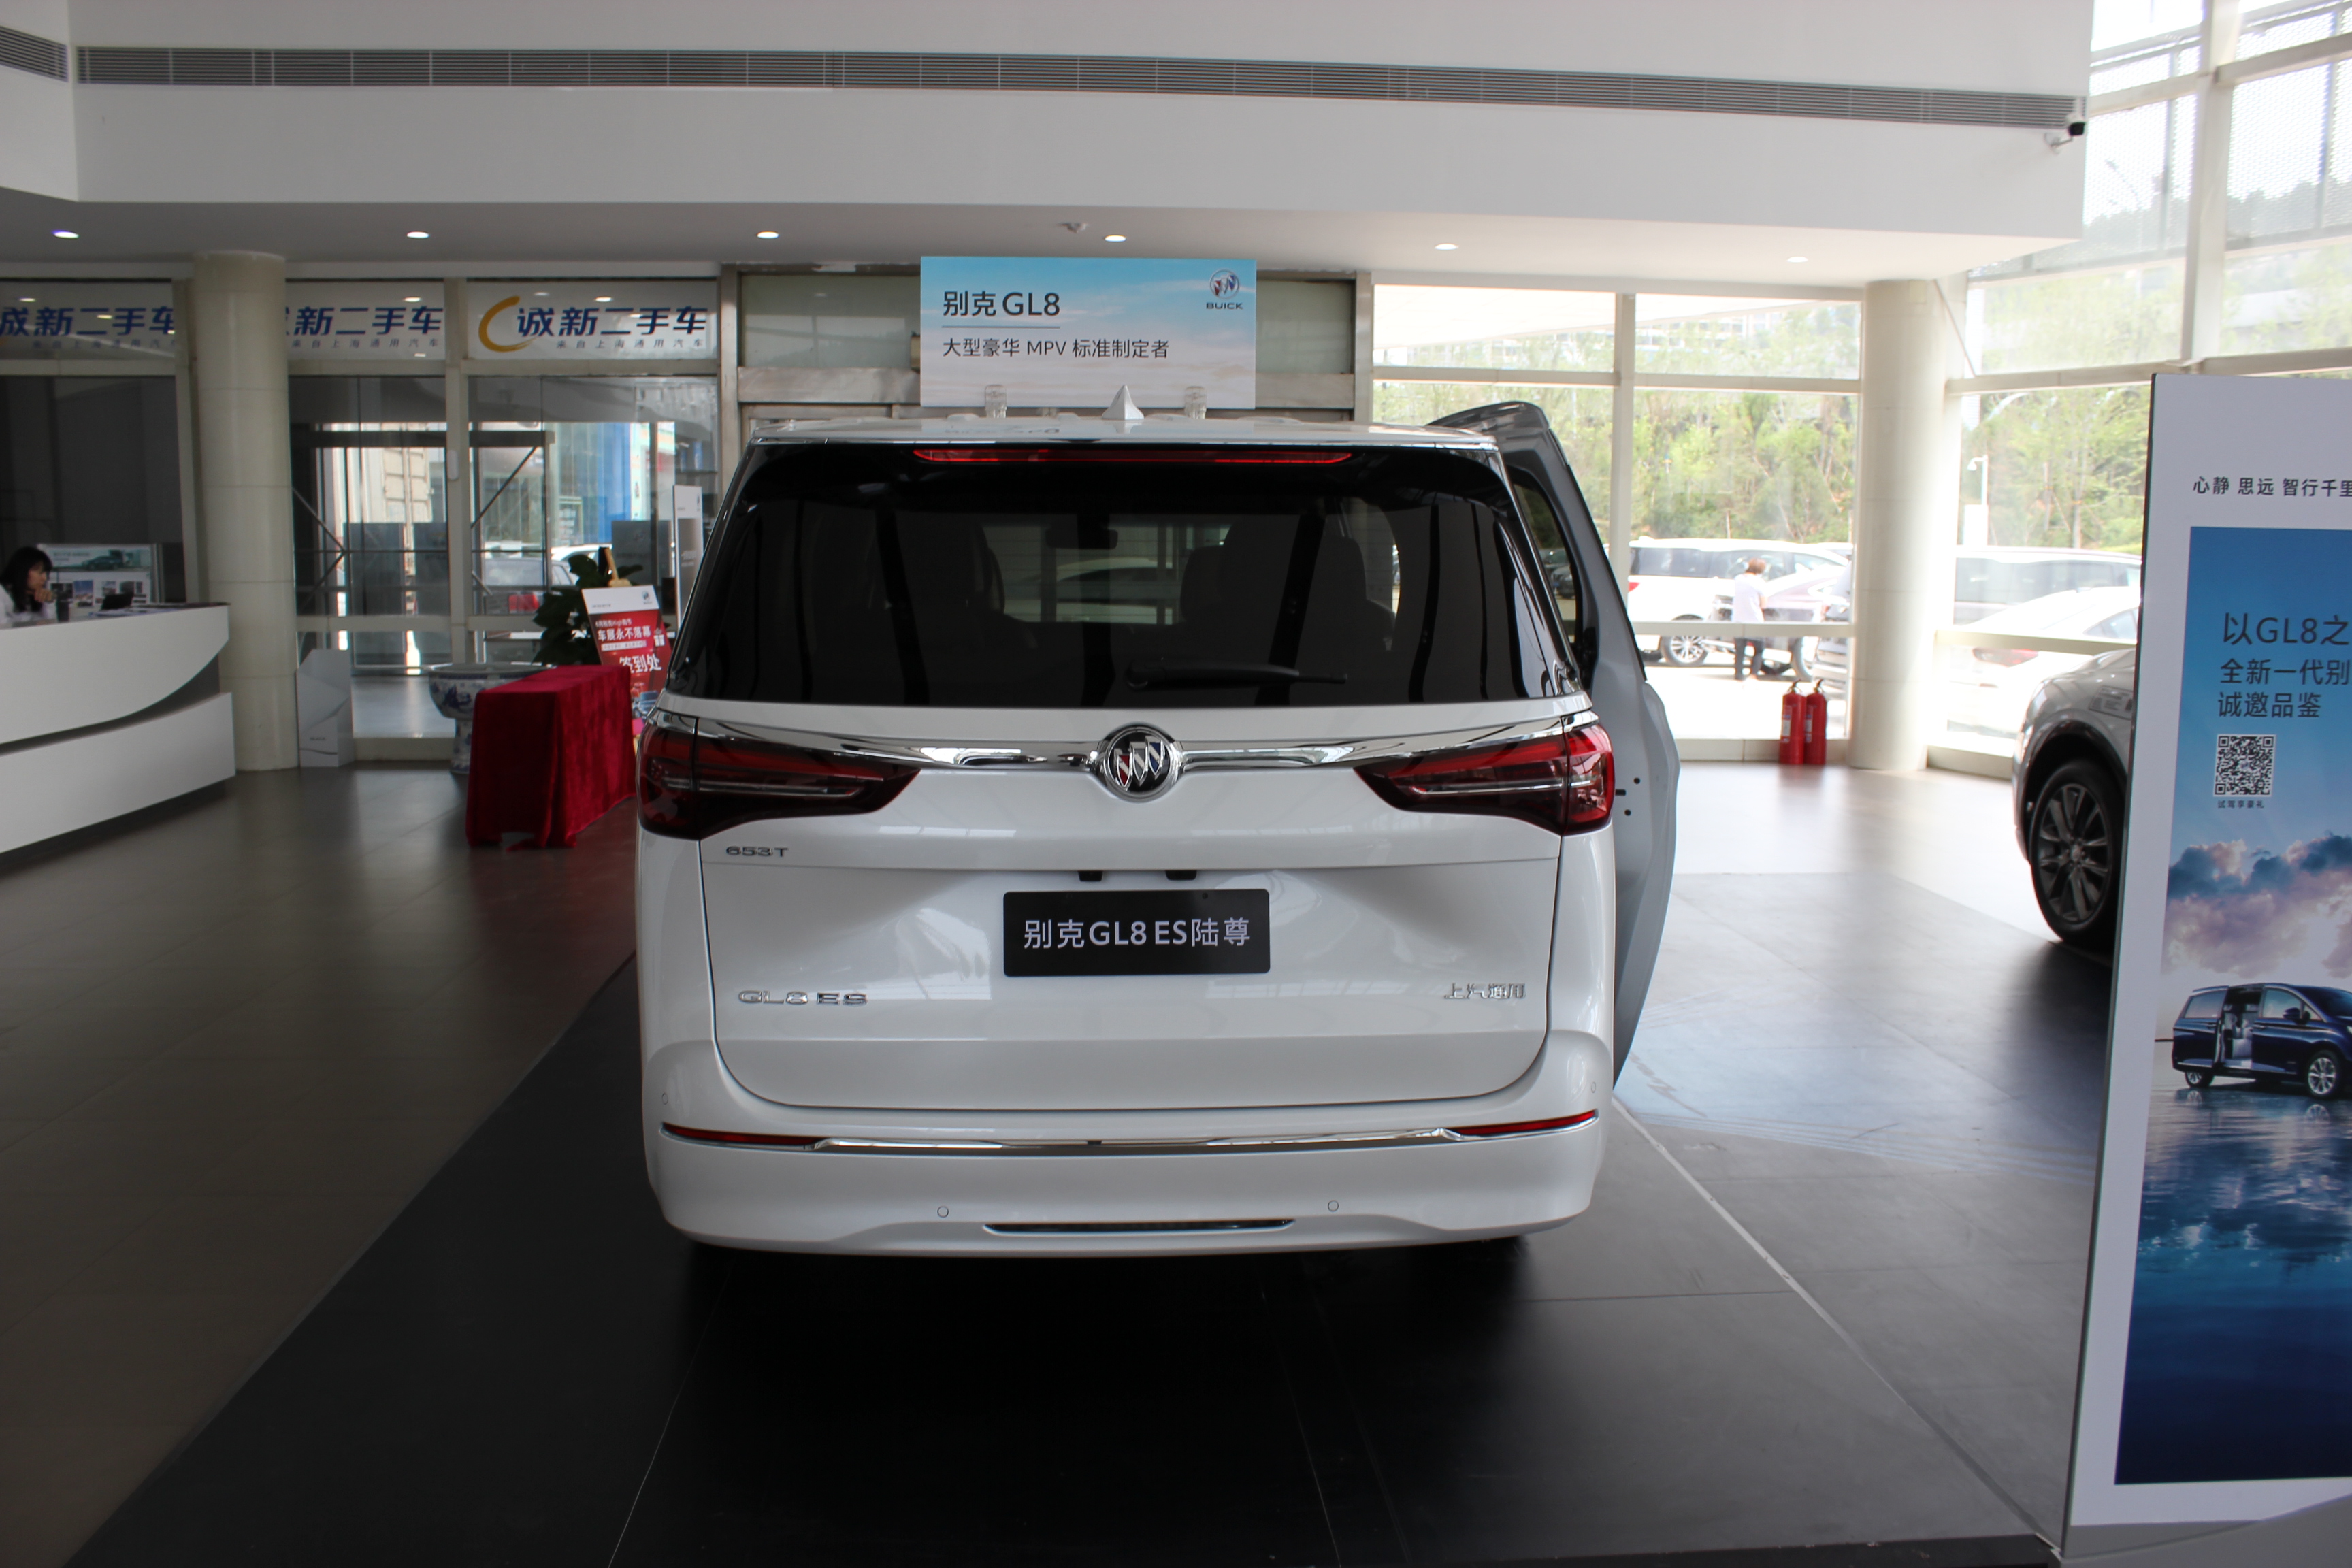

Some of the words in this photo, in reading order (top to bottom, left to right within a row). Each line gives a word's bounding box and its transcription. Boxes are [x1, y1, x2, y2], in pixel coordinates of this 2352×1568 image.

[943, 291, 1060, 316] 别克GL8
[285, 306, 444, 336] 新二手车
[516, 306, 708, 338] 诚新二手车
[943, 338, 1020, 357] 大型豪华
[1027, 341, 1066, 355] MPV
[1072, 339, 1169, 358] 标准制定者
[2193, 476, 2230, 495] 心静
[2238, 478, 2274, 495] 思远
[2223, 612, 2350, 645] 以GL8之
[2220, 658, 2351, 685] 全新一代别
[2217, 691, 2321, 718] 诚邀品鉴
[725, 846, 788, 858] 653T
[1024, 918, 1147, 949] 别克GL8
[1154, 917, 1251, 947] ES陆尊
[738, 990, 808, 1005] GL8
[816, 992, 868, 1006] ES
